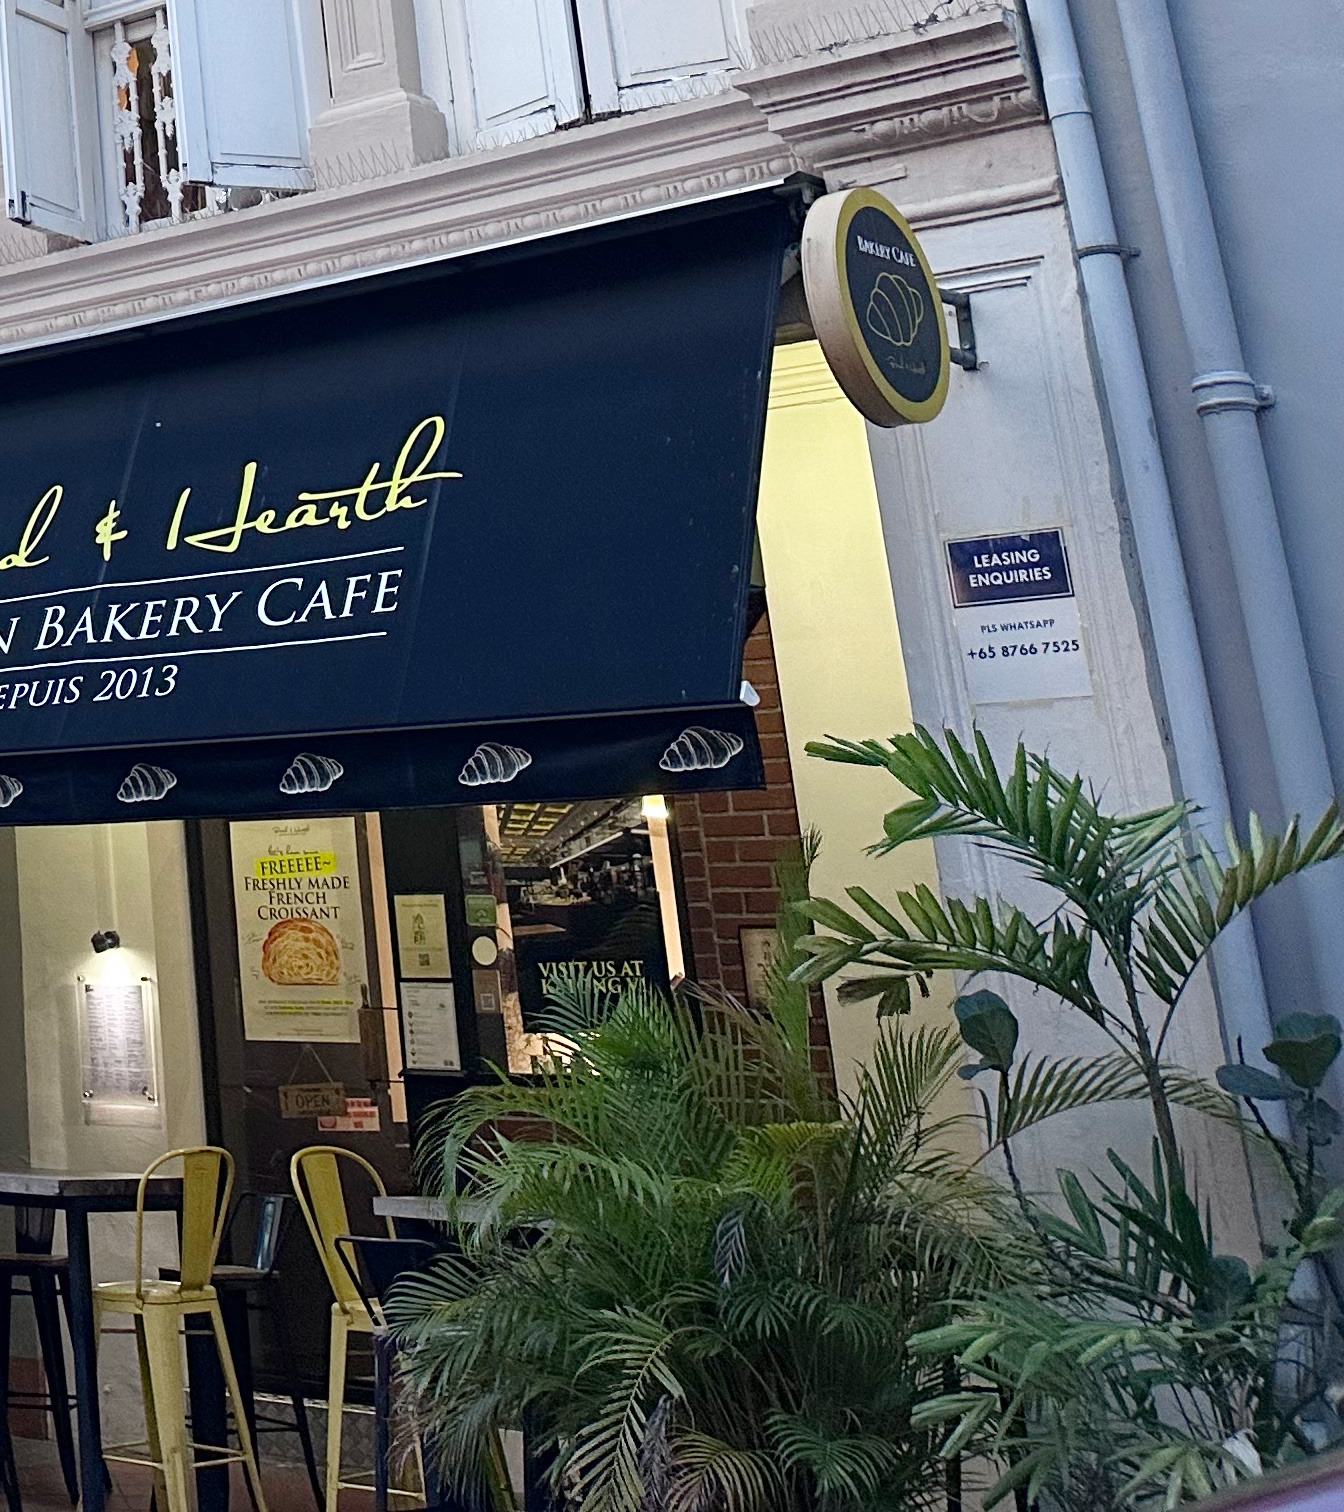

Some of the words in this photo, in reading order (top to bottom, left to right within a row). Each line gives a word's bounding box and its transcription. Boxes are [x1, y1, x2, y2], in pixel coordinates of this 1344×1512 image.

[857, 235, 891, 260] BAKERY
[95, 499, 128, 562] &
[165, 415, 463, 553] Hearth
[973, 549, 1041, 569] LEASING
[968, 566, 1052, 588] ENQUIRIES
[34, 590, 242, 651] BAKERY
[256, 569, 403, 627] CAFE
[980, 623, 998, 634] PLS
[1000, 619, 1055, 633] WHATSAPP
[967, 645, 997, 660] +65
[1001, 643, 1038, 658] 8766
[1042, 639, 1080, 654] 7525
[92, 664, 179, 703] 2013
[244, 877, 303, 891] FRESHLY
[307, 876, 350, 889] MADE
[268, 891, 327, 905] FRENCH
[257, 905, 341, 920] CROISSANT
[538, 961, 588, 978] VISIT
[592, 960, 616, 977] US
[620, 960, 644, 976] AT
[295, 1093, 330, 1108] OPEN
